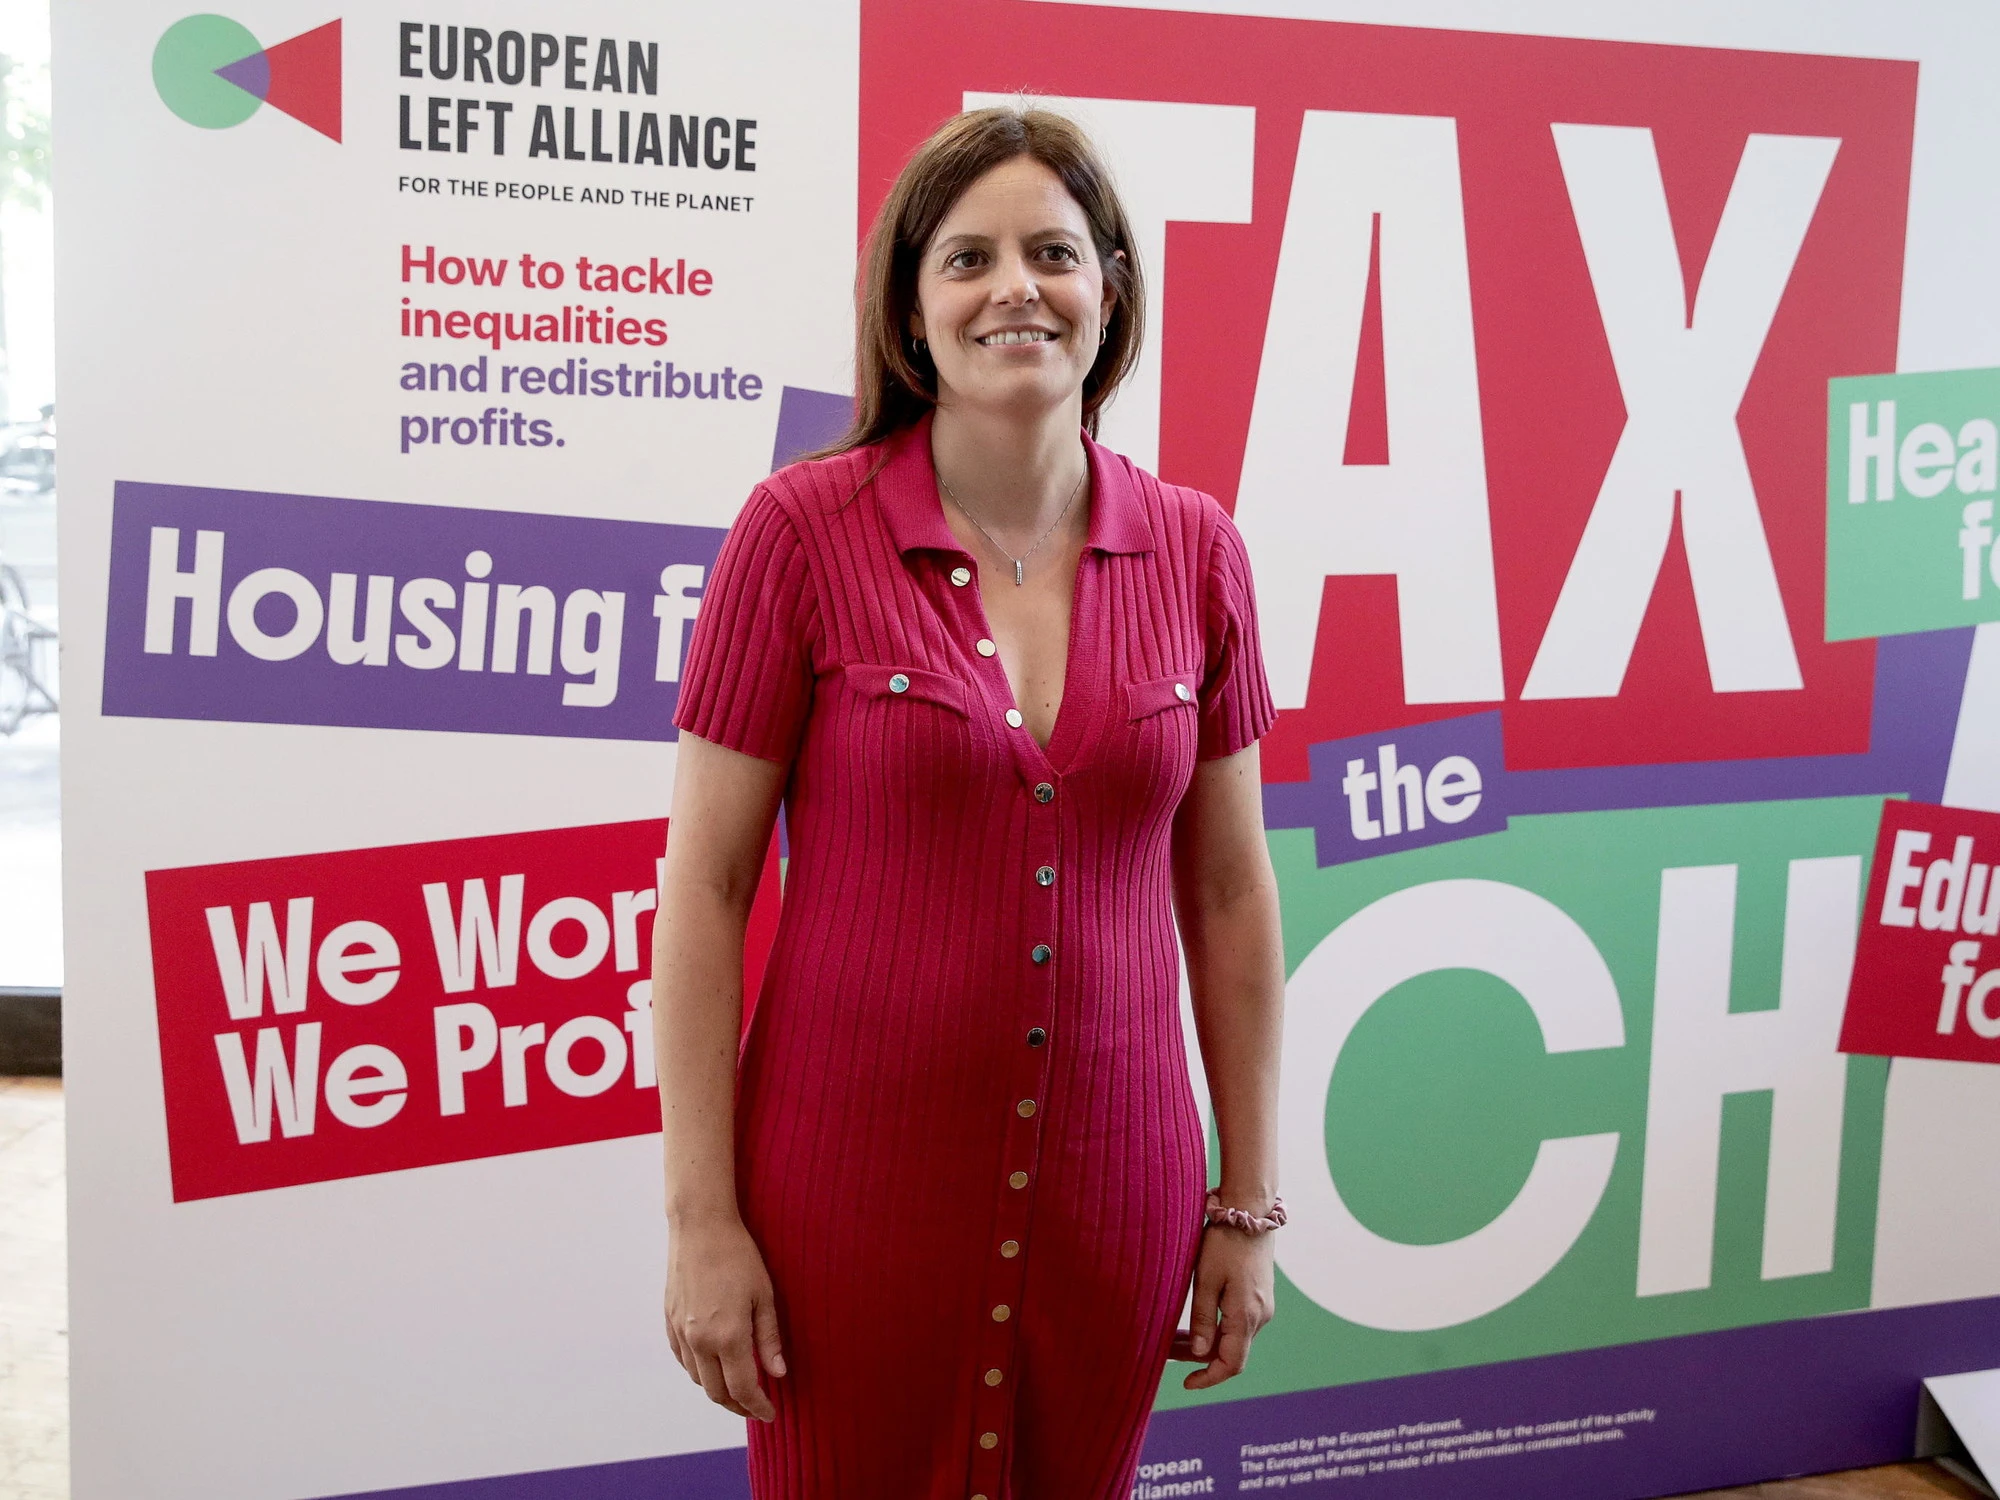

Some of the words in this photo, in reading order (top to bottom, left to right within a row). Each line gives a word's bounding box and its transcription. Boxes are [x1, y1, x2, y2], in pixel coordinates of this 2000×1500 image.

[400, 21, 659, 95] EUROPEAN
[398, 94, 513, 156] LEFT
[528, 104, 757, 171] ALLIANCE
[399, 176, 440, 193] FOR
[447, 179, 488, 197] THE
[495, 182, 573, 202] PEOPLE
[580, 188, 624, 205] AND
[631, 190, 670, 207] THE
[676, 193, 754, 212] PLANET
[401, 245, 508, 286] How
[519, 254, 564, 290] to
[576, 256, 713, 296] tackle
[401, 298, 667, 350] inequalities
[400, 356, 488, 393] and
[501, 358, 763, 401] redistribute
[401, 407, 565, 454] profits.
[1959, 499, 2000, 600] f
[144, 526, 626, 707] Housing
[1342, 743, 1482, 840] the
[205, 897, 401, 1021] We
[423, 858, 666, 993] Wor
[214, 1022, 408, 1145] We
[1174, 855, 1862, 1331] CH
[1238, 1474, 1264, 1491] and
[1265, 1474, 1288, 1489] any
[1290, 1470, 1313, 1484] use
[1315, 1465, 1339, 1481] that
[1340, 1463, 1367, 1478] may
[1368, 1460, 1386, 1473] be
[1386, 1455, 1421, 1471] made
[1422, 1451, 1437, 1466] of
[1437, 1450, 1457, 1464] the
[1457, 1442, 1524, 1461] information
[1525, 1431, 1582, 1453] contained
[1240, 1461, 1264, 1474] The
[1266, 1453, 1325, 1471] European
[1326, 1443, 1391, 1463] Parliament
[1392, 1440, 1404, 1454] is
[1405, 1439, 1425, 1452] not
[1426, 1429, 1494, 1450] responsible
[1496, 1426, 1513, 1440] for
[1514, 1425, 1534, 1438] the
[1535, 1418, 1579, 1435] content
[1580, 1415, 1593, 1429] of
[1594, 1414, 1614, 1427] the
[1615, 1408, 1657, 1424] activity
[1240, 1436, 1298, 1457] Financed
[1299, 1436, 1316, 1452] by
[1317, 1435, 1338, 1449] the
[1339, 1427, 1397, 1445] European
